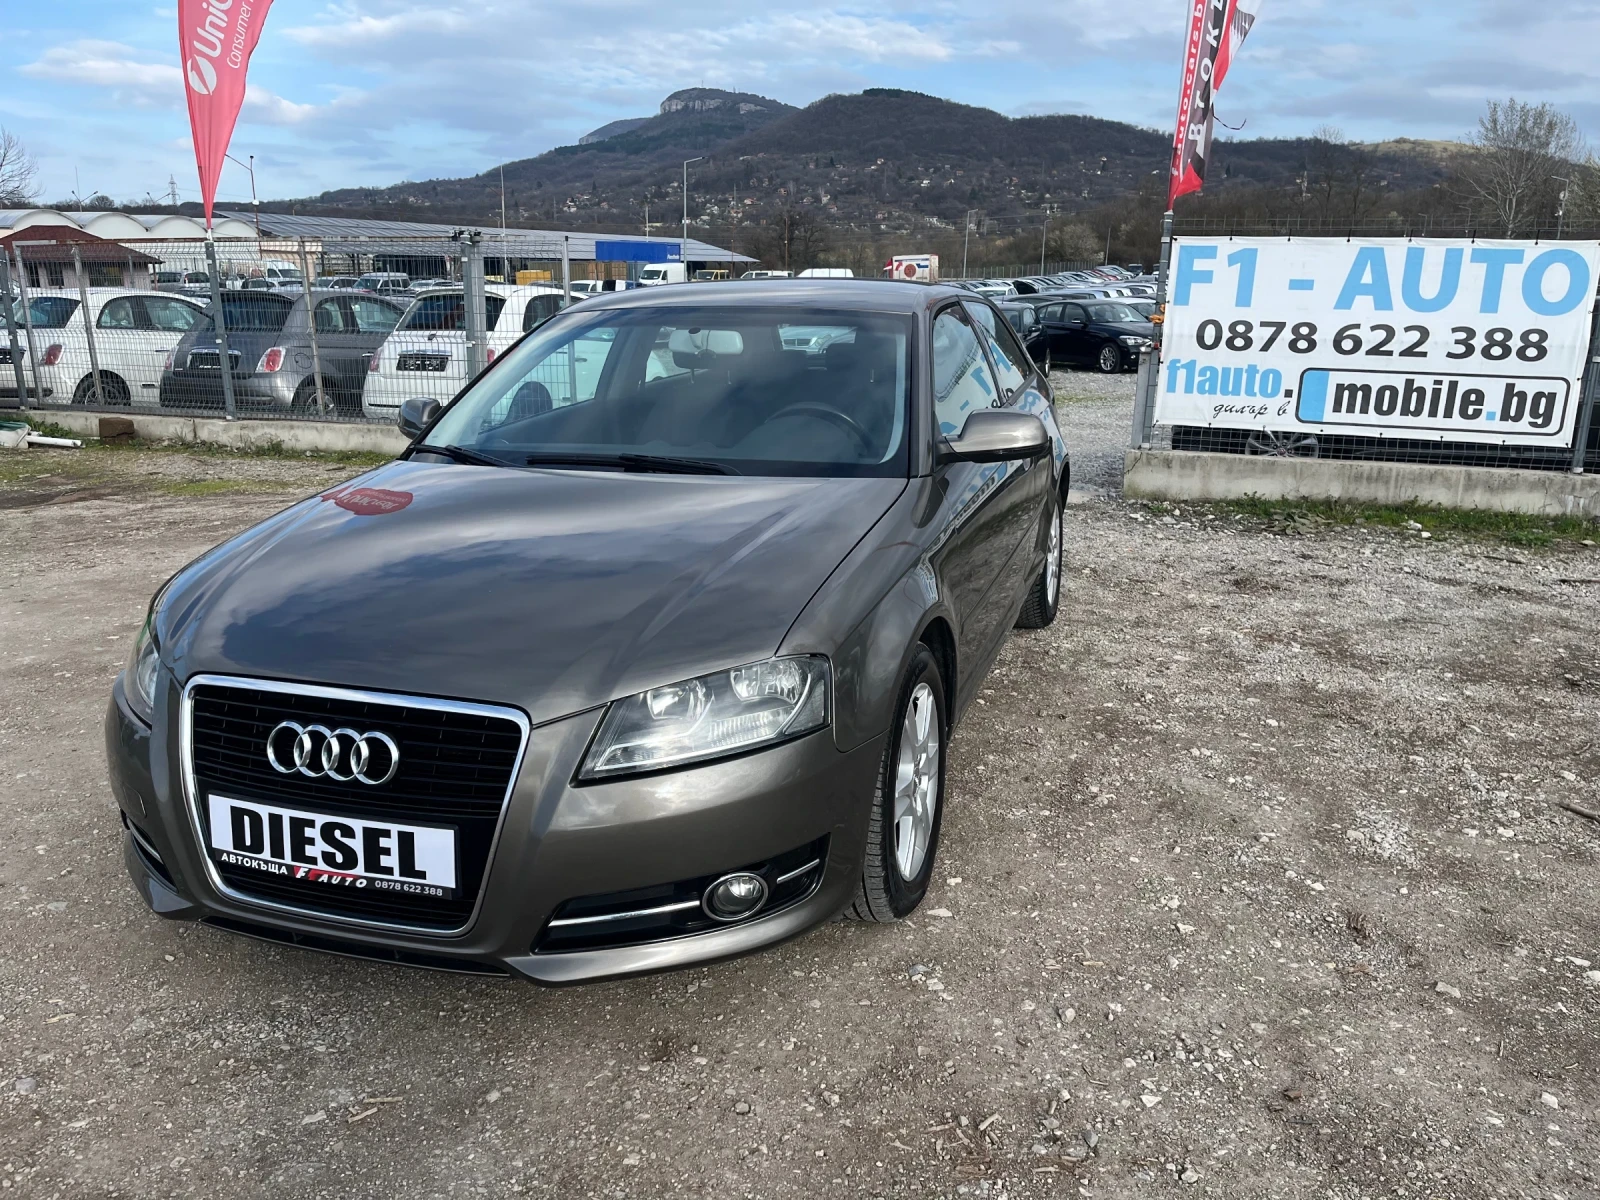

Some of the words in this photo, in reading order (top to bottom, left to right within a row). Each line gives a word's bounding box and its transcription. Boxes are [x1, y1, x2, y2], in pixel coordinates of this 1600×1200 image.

[227, 2, 251, 68] Consumer
[1173, 245, 1258, 307] F1
[1288, 279, 1315, 291] -
[1333, 246, 1591, 317] AUTO
[1197, 319, 1318, 354] 0878
[1332, 323, 1430, 358] 622
[1446, 326, 1549, 362] 388
[1332, 378, 1558, 429] mobile.bg
[221, 852, 288, 875] АВТОКЪЩА
[230, 805, 427, 880] DIESEL
[318, 874, 368, 888] AUTO
[375, 880, 401, 891] 0878
[404, 884, 421, 893] 622
[423, 886, 443, 897] 388
